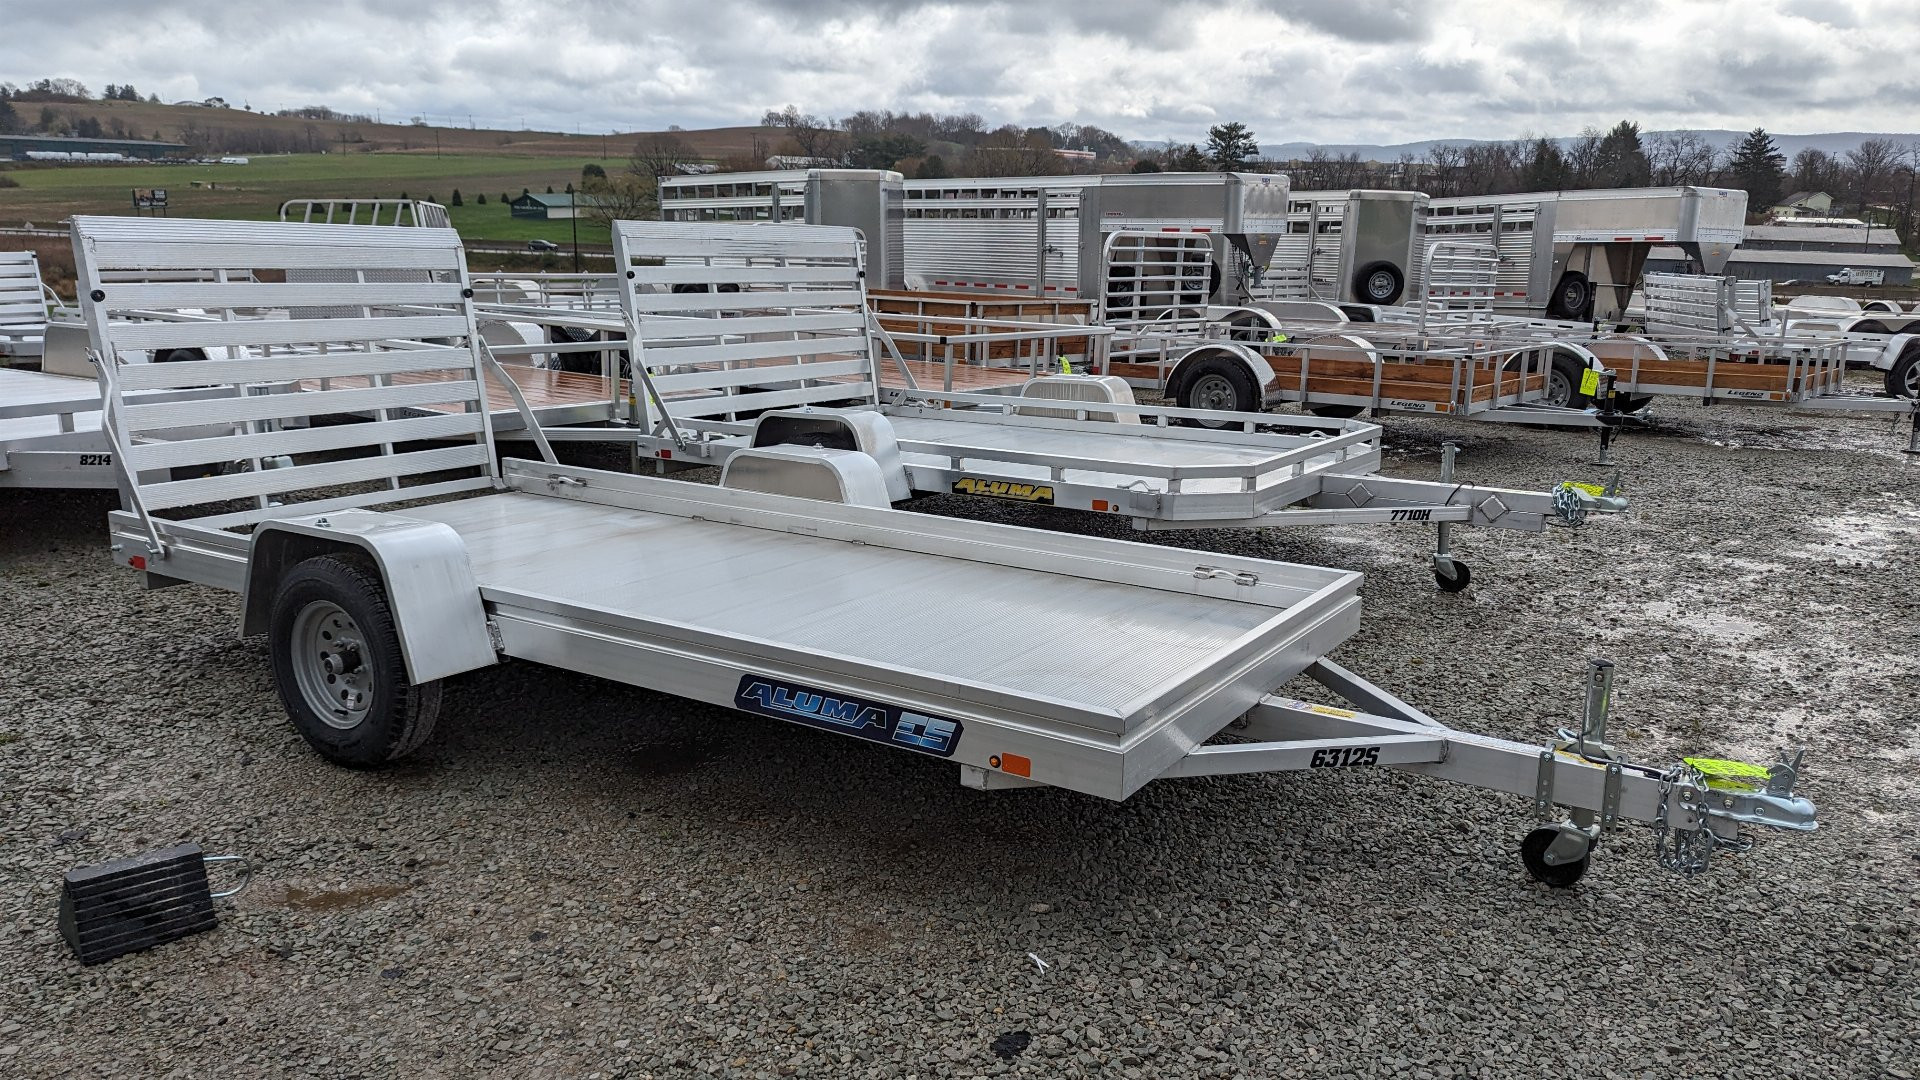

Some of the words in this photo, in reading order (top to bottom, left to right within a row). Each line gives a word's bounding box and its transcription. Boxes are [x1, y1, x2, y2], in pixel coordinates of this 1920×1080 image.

[1390, 400, 1426, 408] LEGEND
[80, 454, 112, 466] 8214
[954, 477, 1054, 501] ALUMA
[1390, 509, 1432, 521] 7710H
[741, 682, 887, 730] ALUMA
[1310, 747, 1381, 768] 6312S
